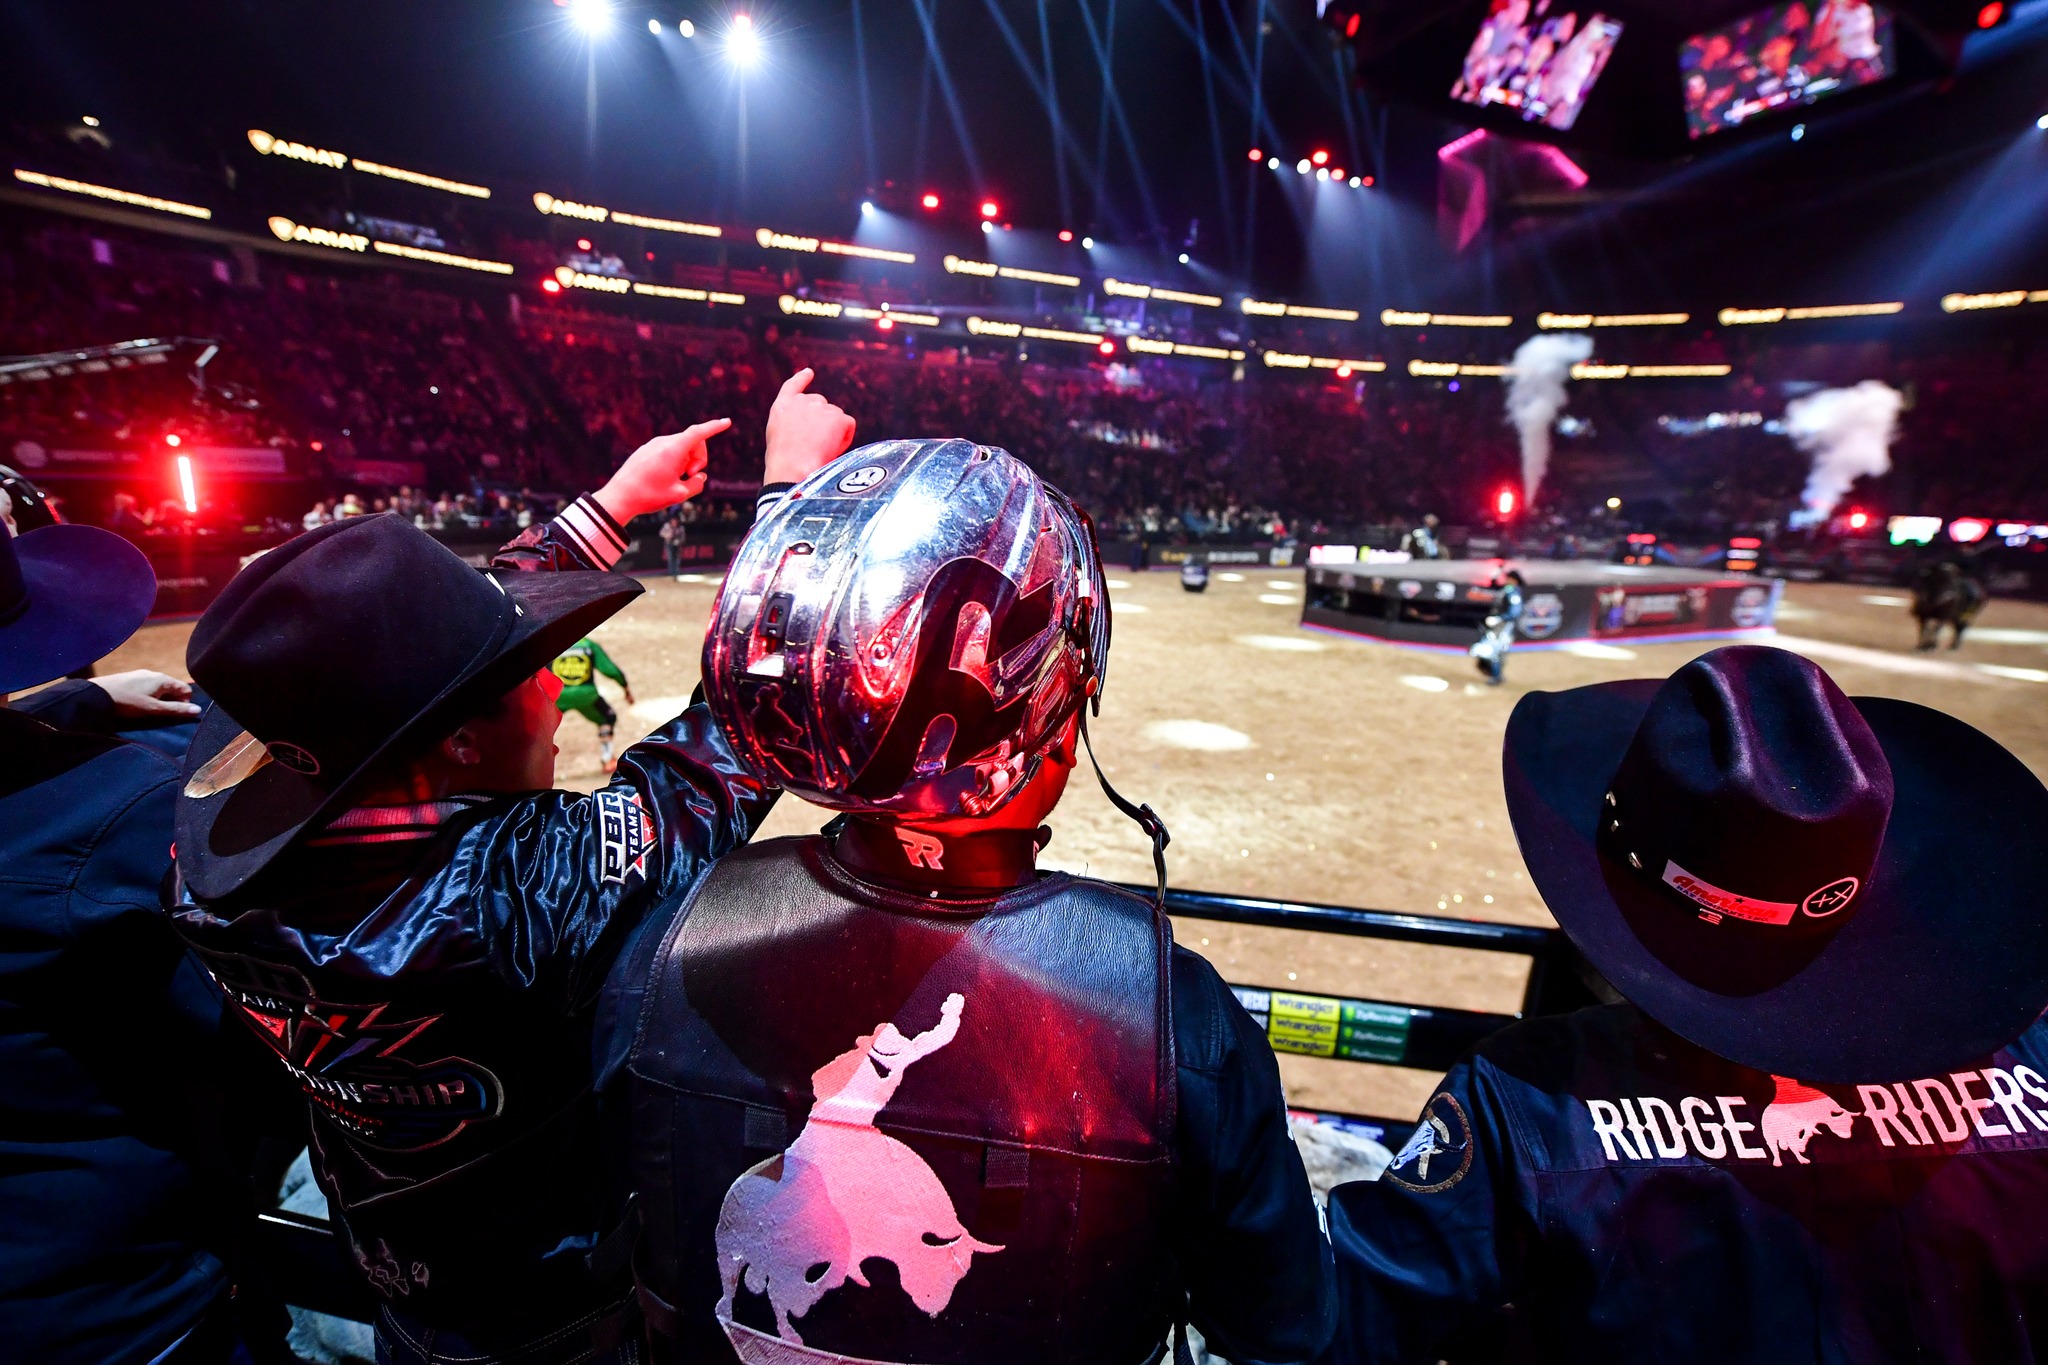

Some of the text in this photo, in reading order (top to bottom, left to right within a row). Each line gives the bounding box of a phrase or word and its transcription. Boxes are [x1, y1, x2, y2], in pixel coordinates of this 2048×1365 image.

[272, 139, 348, 169] ARIAT
[293, 225, 369, 252] ARIAT
[627, 805, 640, 856] TEAMS
[1672, 875, 1778, 918] American
[1586, 1065, 2048, 1161] RIDGE RIDERS
